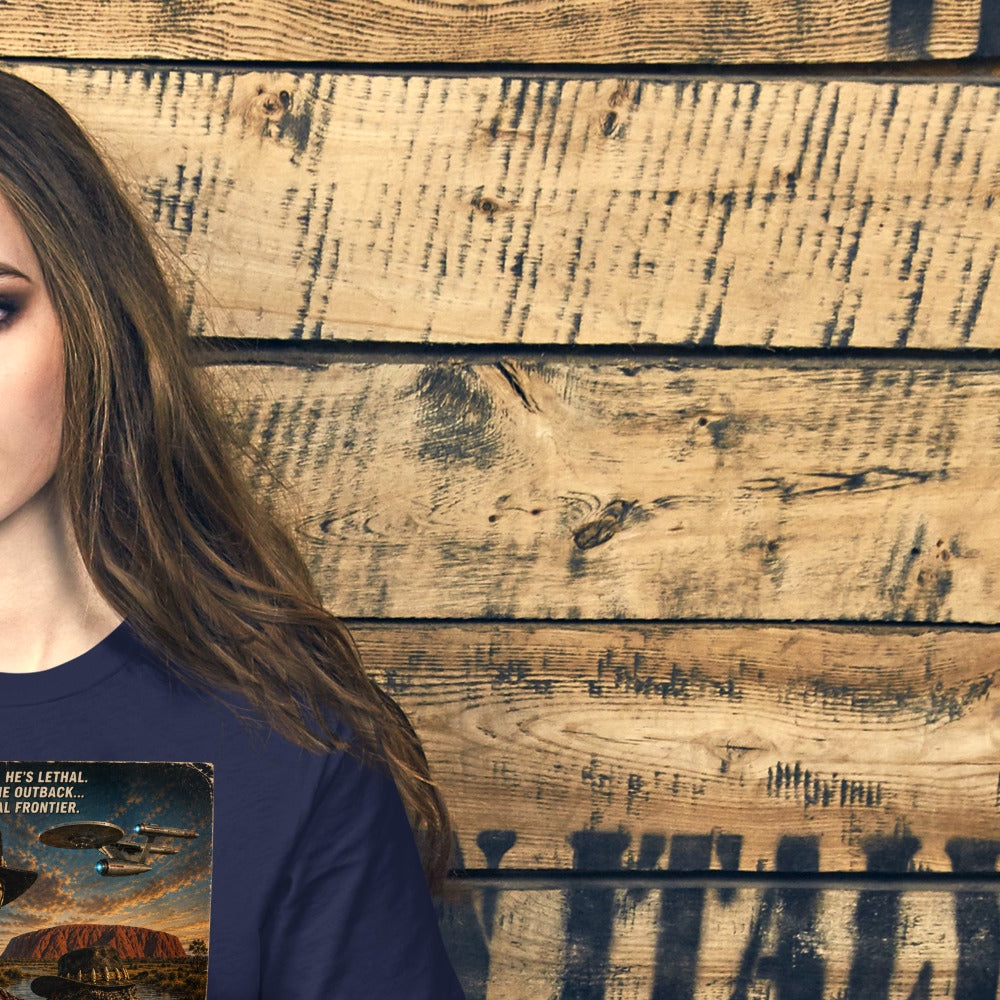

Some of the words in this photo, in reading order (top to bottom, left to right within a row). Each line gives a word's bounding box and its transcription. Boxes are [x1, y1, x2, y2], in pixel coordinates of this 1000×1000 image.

[5, 771, 33, 784] HE'S
[37, 771, 88, 784] LETHAL.
[14, 786, 85, 799] OUTBACK...
[14, 801, 80, 814] FRONTIER.
